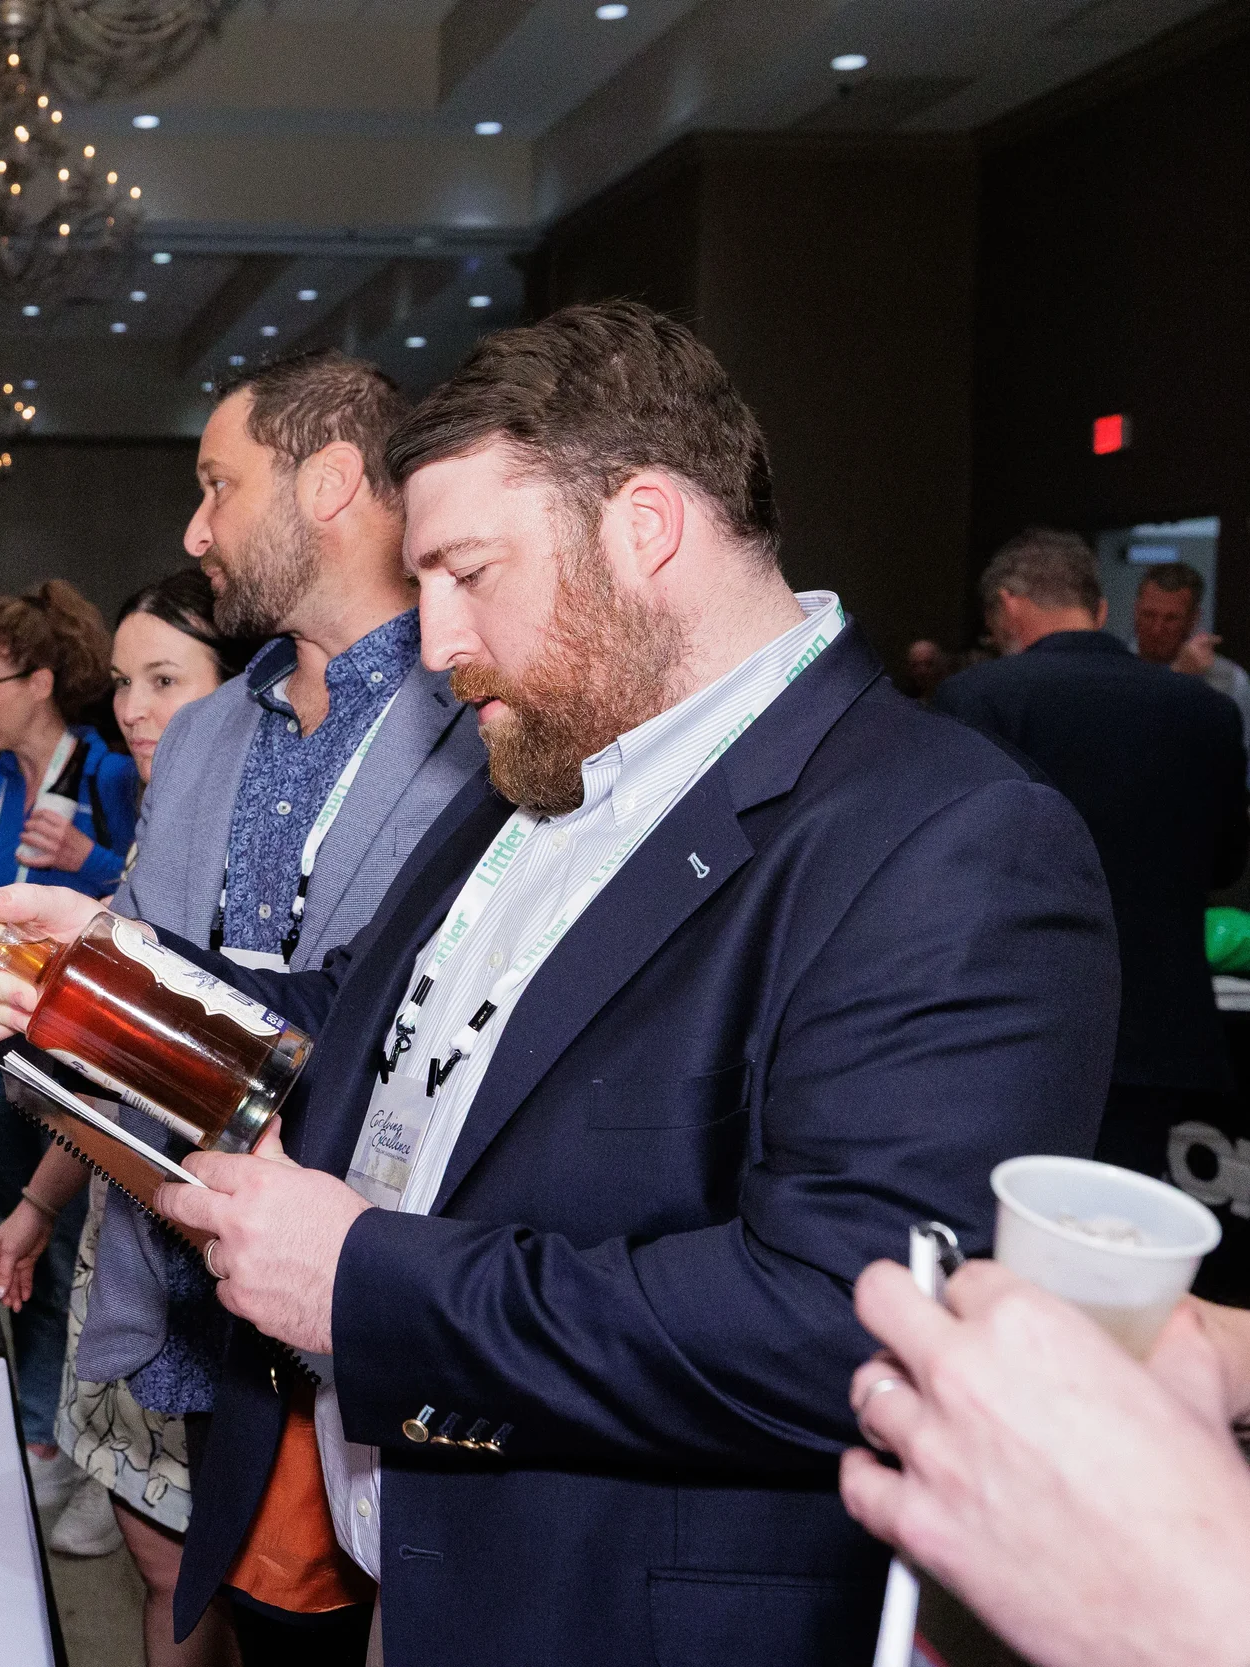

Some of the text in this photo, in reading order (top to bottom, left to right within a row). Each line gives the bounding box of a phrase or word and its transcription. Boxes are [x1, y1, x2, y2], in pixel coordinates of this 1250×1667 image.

[315, 783, 350, 834] Littler
[475, 821, 527, 887] Littler
[513, 915, 569, 974] Littler
[372, 1128, 411, 1155] Excellence
